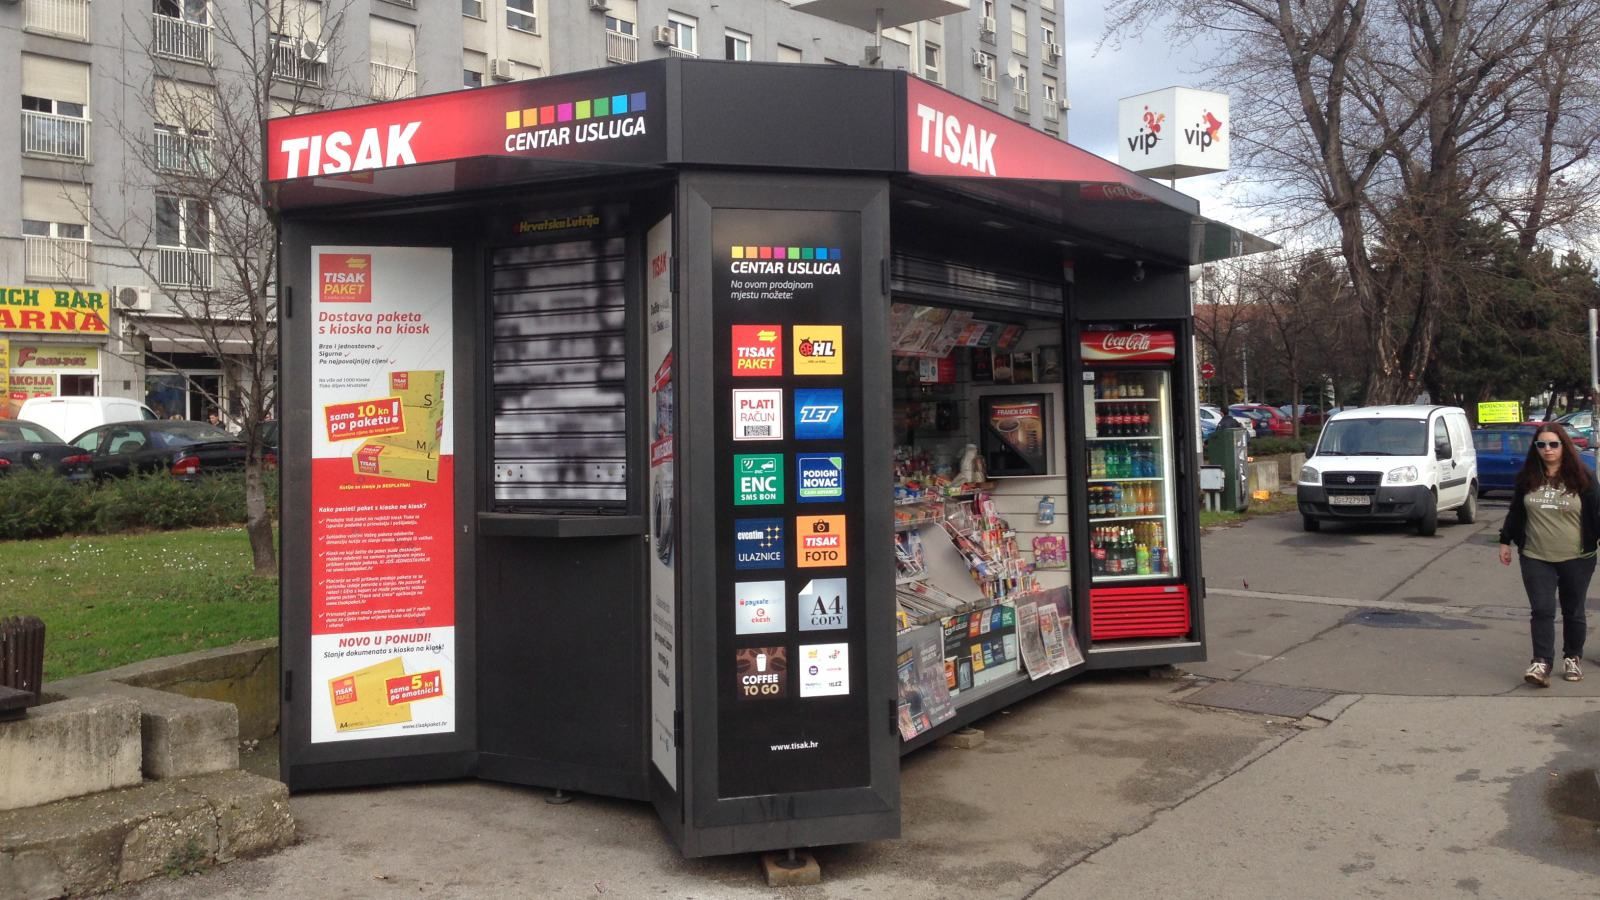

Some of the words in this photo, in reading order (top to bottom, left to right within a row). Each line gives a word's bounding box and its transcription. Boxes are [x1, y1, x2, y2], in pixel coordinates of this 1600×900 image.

[505, 127, 570, 152] CENTAR
[575, 116, 646, 142] USLUGA
[1184, 123, 1213, 152] vip
[917, 103, 998, 177] TISAK
[1128, 127, 1157, 155] vip
[281, 121, 422, 179] TISAK
[730, 261, 784, 274] CENTAR
[787, 262, 841, 275] USLUGA
[324, 272, 365, 283] TISAK
[323, 284, 365, 295] PAKET
[731, 280, 742, 289] Na
[769, 280, 814, 290] prodajnom
[54, 291, 104, 308] BAR
[731, 291, 759, 300] mjestu
[760, 290, 793, 300] možete:
[0, 309, 105, 331] ARNA
[319, 311, 372, 322] Dostava
[377, 311, 421, 324] paketa
[318, 325, 325, 334] s
[330, 323, 371, 334] kioska
[376, 325, 392, 334] na
[396, 323, 429, 334] kiosk
[737, 347, 776, 357] TISAK
[737, 358, 775, 369] PAKET
[9, 376, 54, 385] AKCIJA
[424, 394, 432, 406] S
[740, 399, 774, 409] PLATI
[329, 412, 355, 422] samo
[358, 404, 376, 417] 10
[378, 407, 389, 415] kn
[740, 410, 775, 422] RAČUN
[800, 405, 839, 423] ZET
[331, 421, 346, 432] po
[416, 440, 426, 450] M
[426, 469, 436, 481] L
[803, 470, 838, 478] PODIGNI
[741, 476, 777, 493] ENC
[803, 478, 838, 488] NOVAC
[741, 493, 757, 501] SMS
[356, 504, 374, 512] paket
[737, 530, 764, 540] eventim
[805, 536, 838, 547] TISAK
[738, 551, 781, 562] ULAZNICE
[805, 550, 838, 562] FOTO
[811, 594, 844, 616] A4
[811, 615, 843, 626] COPY
[339, 637, 370, 648] NOVO
[374, 636, 382, 646] U
[385, 633, 432, 645] PONUDI!
[324, 651, 344, 659] Slanje
[346, 648, 387, 657] dokumenata
[393, 646, 415, 654] kioska
[389, 686, 410, 695] samo
[411, 675, 422, 690] 5
[742, 674, 779, 685] COFFEE
[335, 686, 353, 695] TISAK
[743, 685, 759, 696] TO
[761, 684, 779, 694] GO
[390, 694, 400, 702] po
[339, 721, 348, 729] A4
[771, 741, 819, 751] www.tisak.hr
